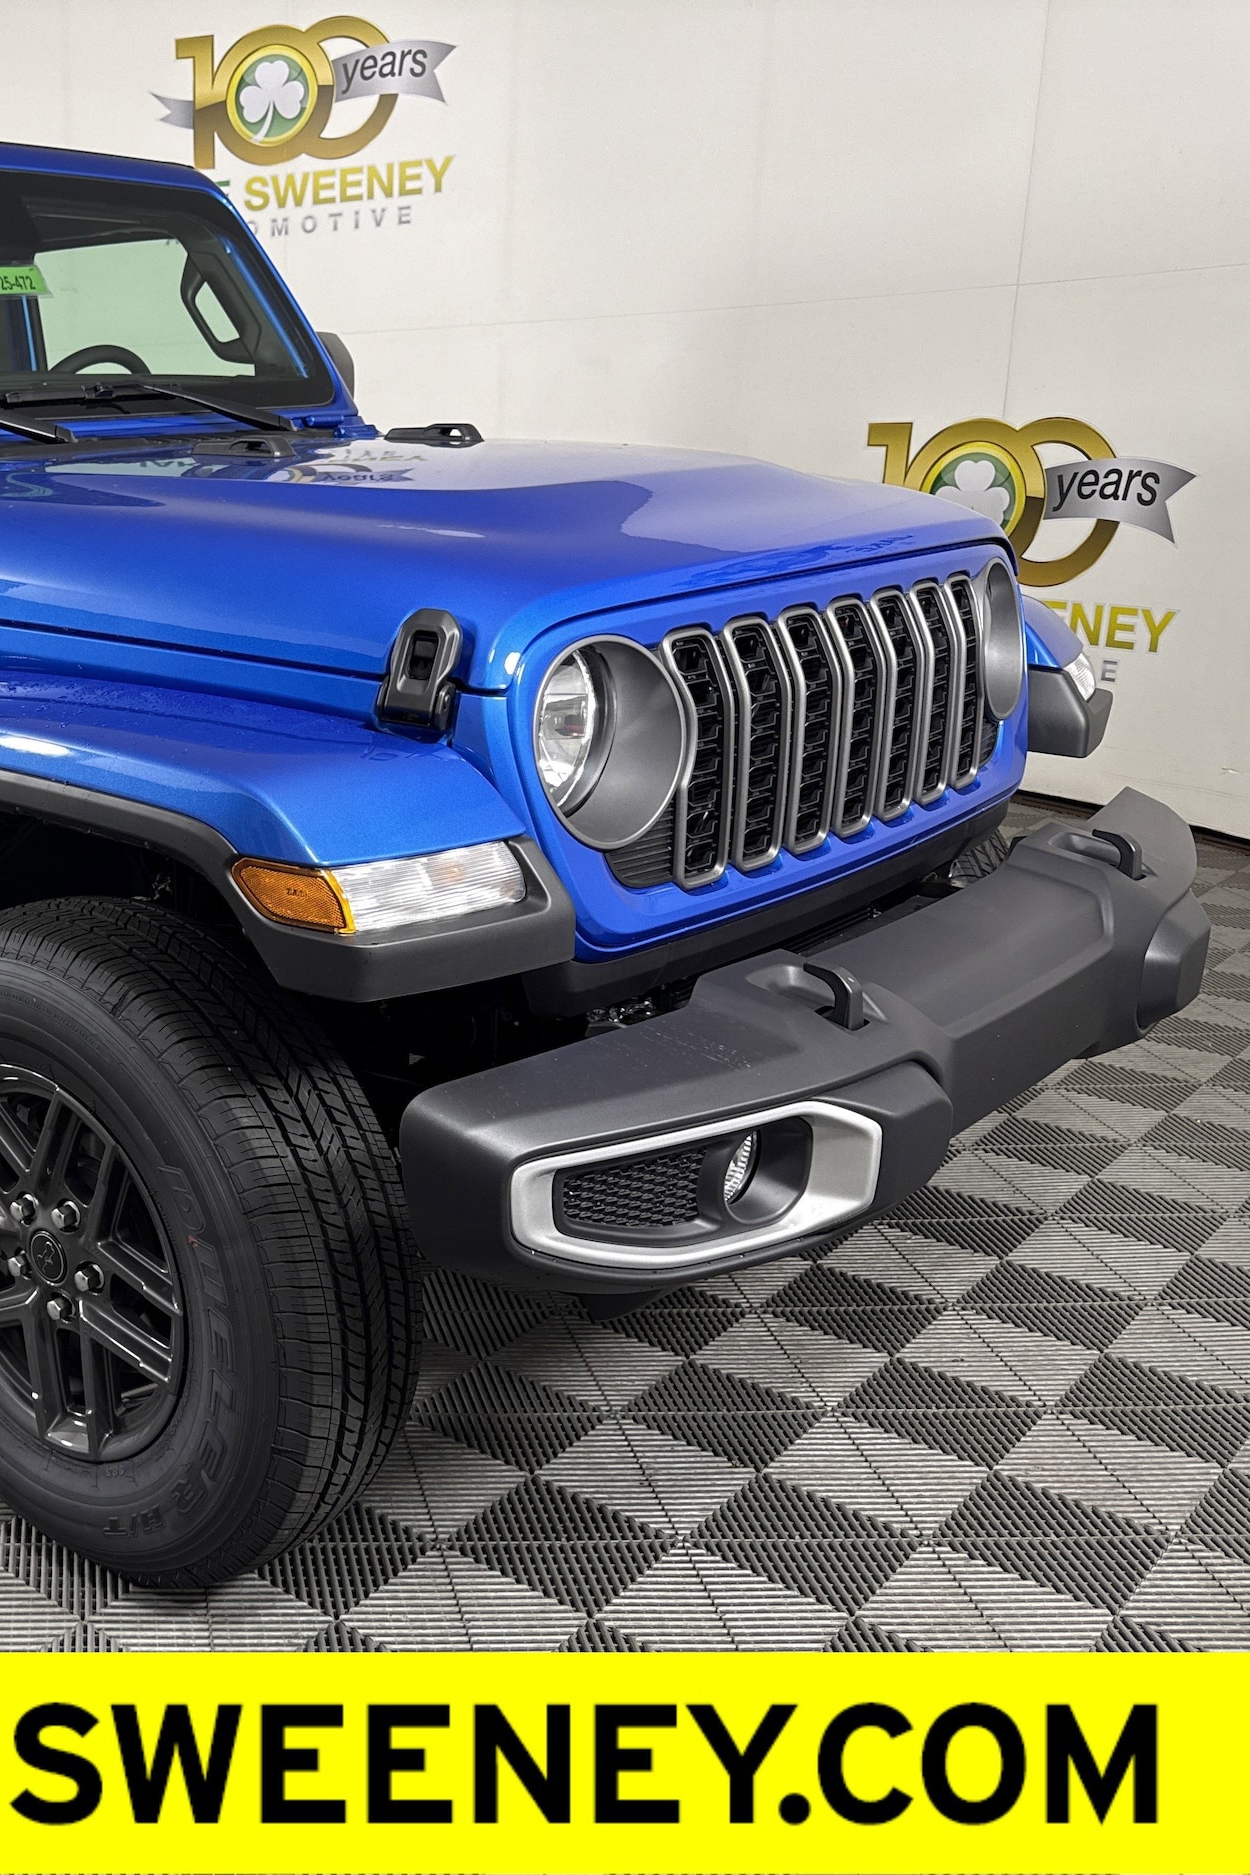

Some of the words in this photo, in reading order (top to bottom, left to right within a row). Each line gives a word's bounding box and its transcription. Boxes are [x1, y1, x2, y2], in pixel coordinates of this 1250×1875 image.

[341, 48, 428, 96] years
[244, 156, 453, 211] SWEENEY
[247, 206, 412, 237] OMOTIVE
[1052, 468, 1161, 512] years
[158, 1165, 236, 1514] DUELER
